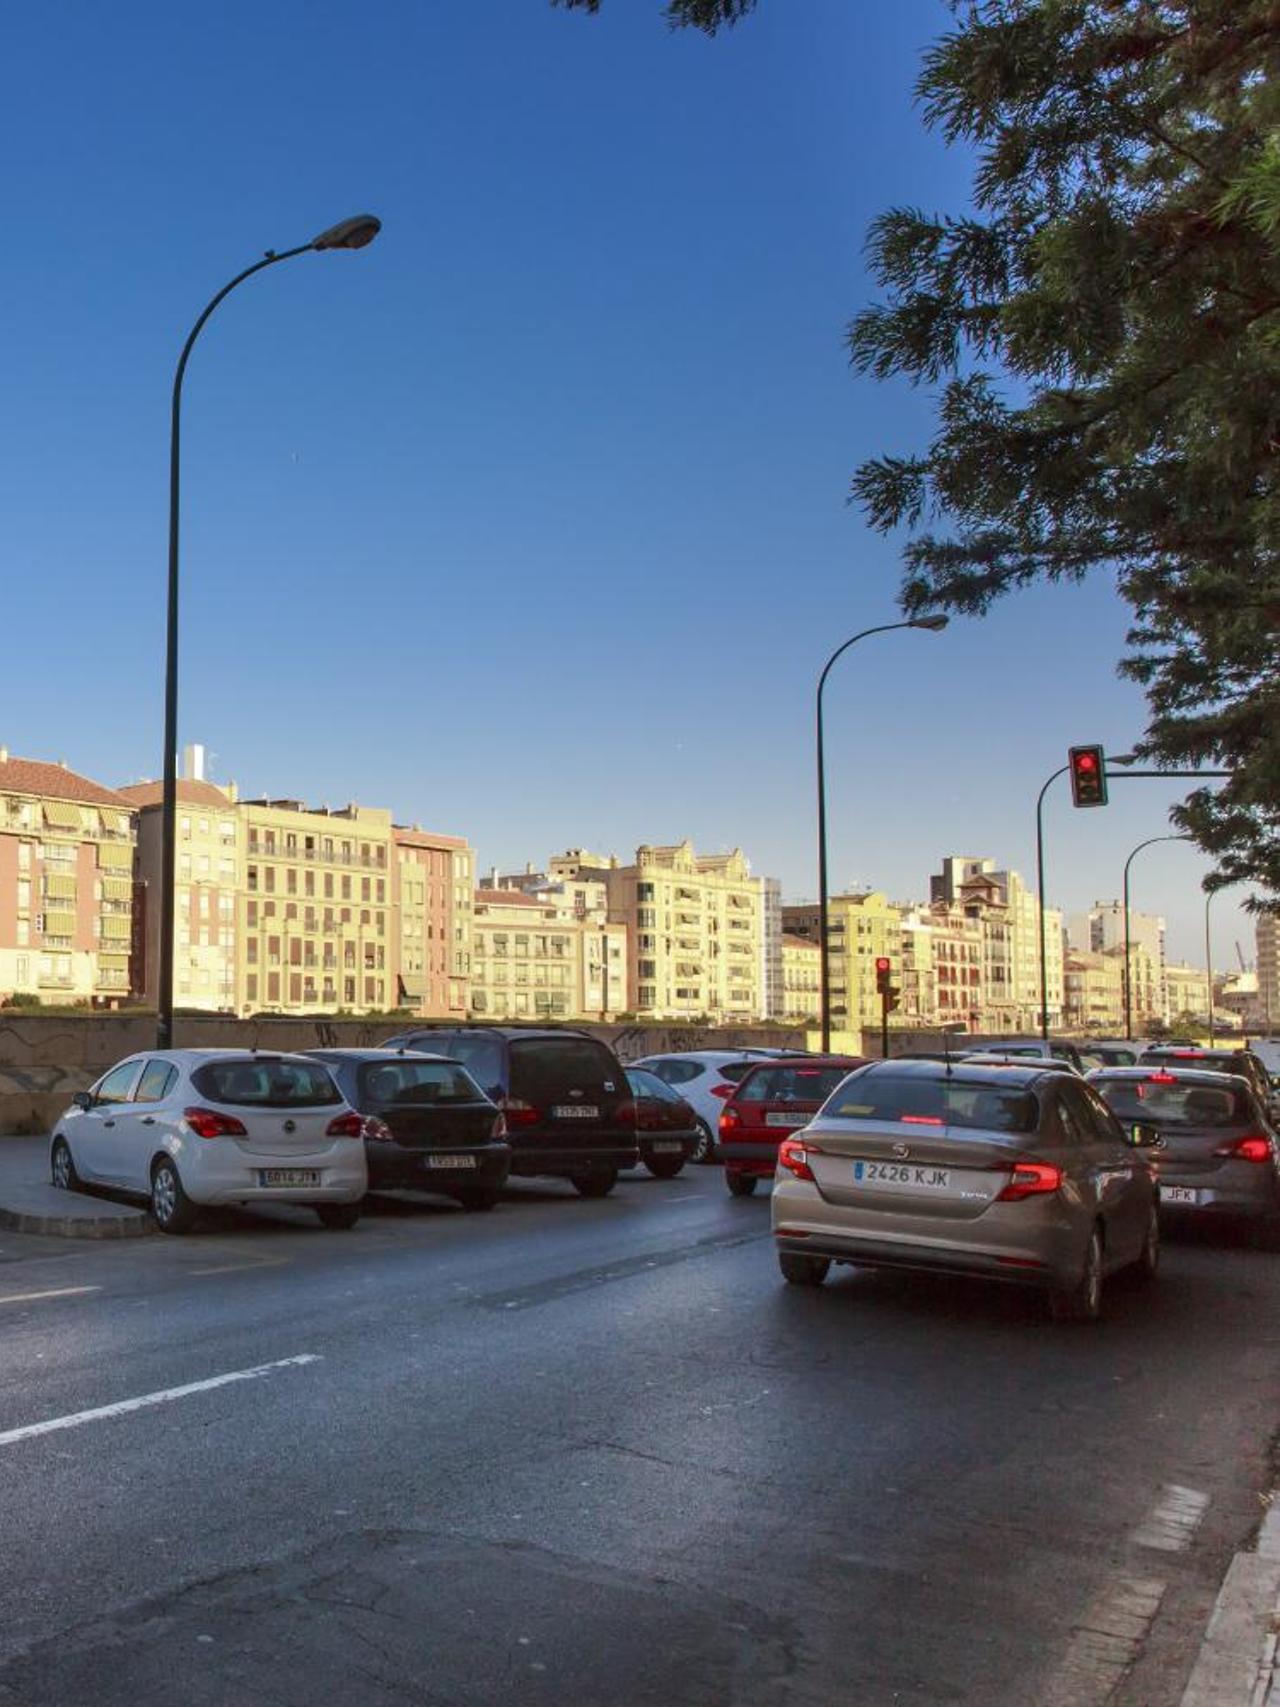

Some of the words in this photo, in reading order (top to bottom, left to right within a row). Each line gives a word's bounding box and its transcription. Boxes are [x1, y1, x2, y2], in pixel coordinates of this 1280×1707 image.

[868, 1164, 910, 1182] 2426
[915, 1169, 948, 1186] KJK
[1167, 1188, 1191, 1201] JFK
